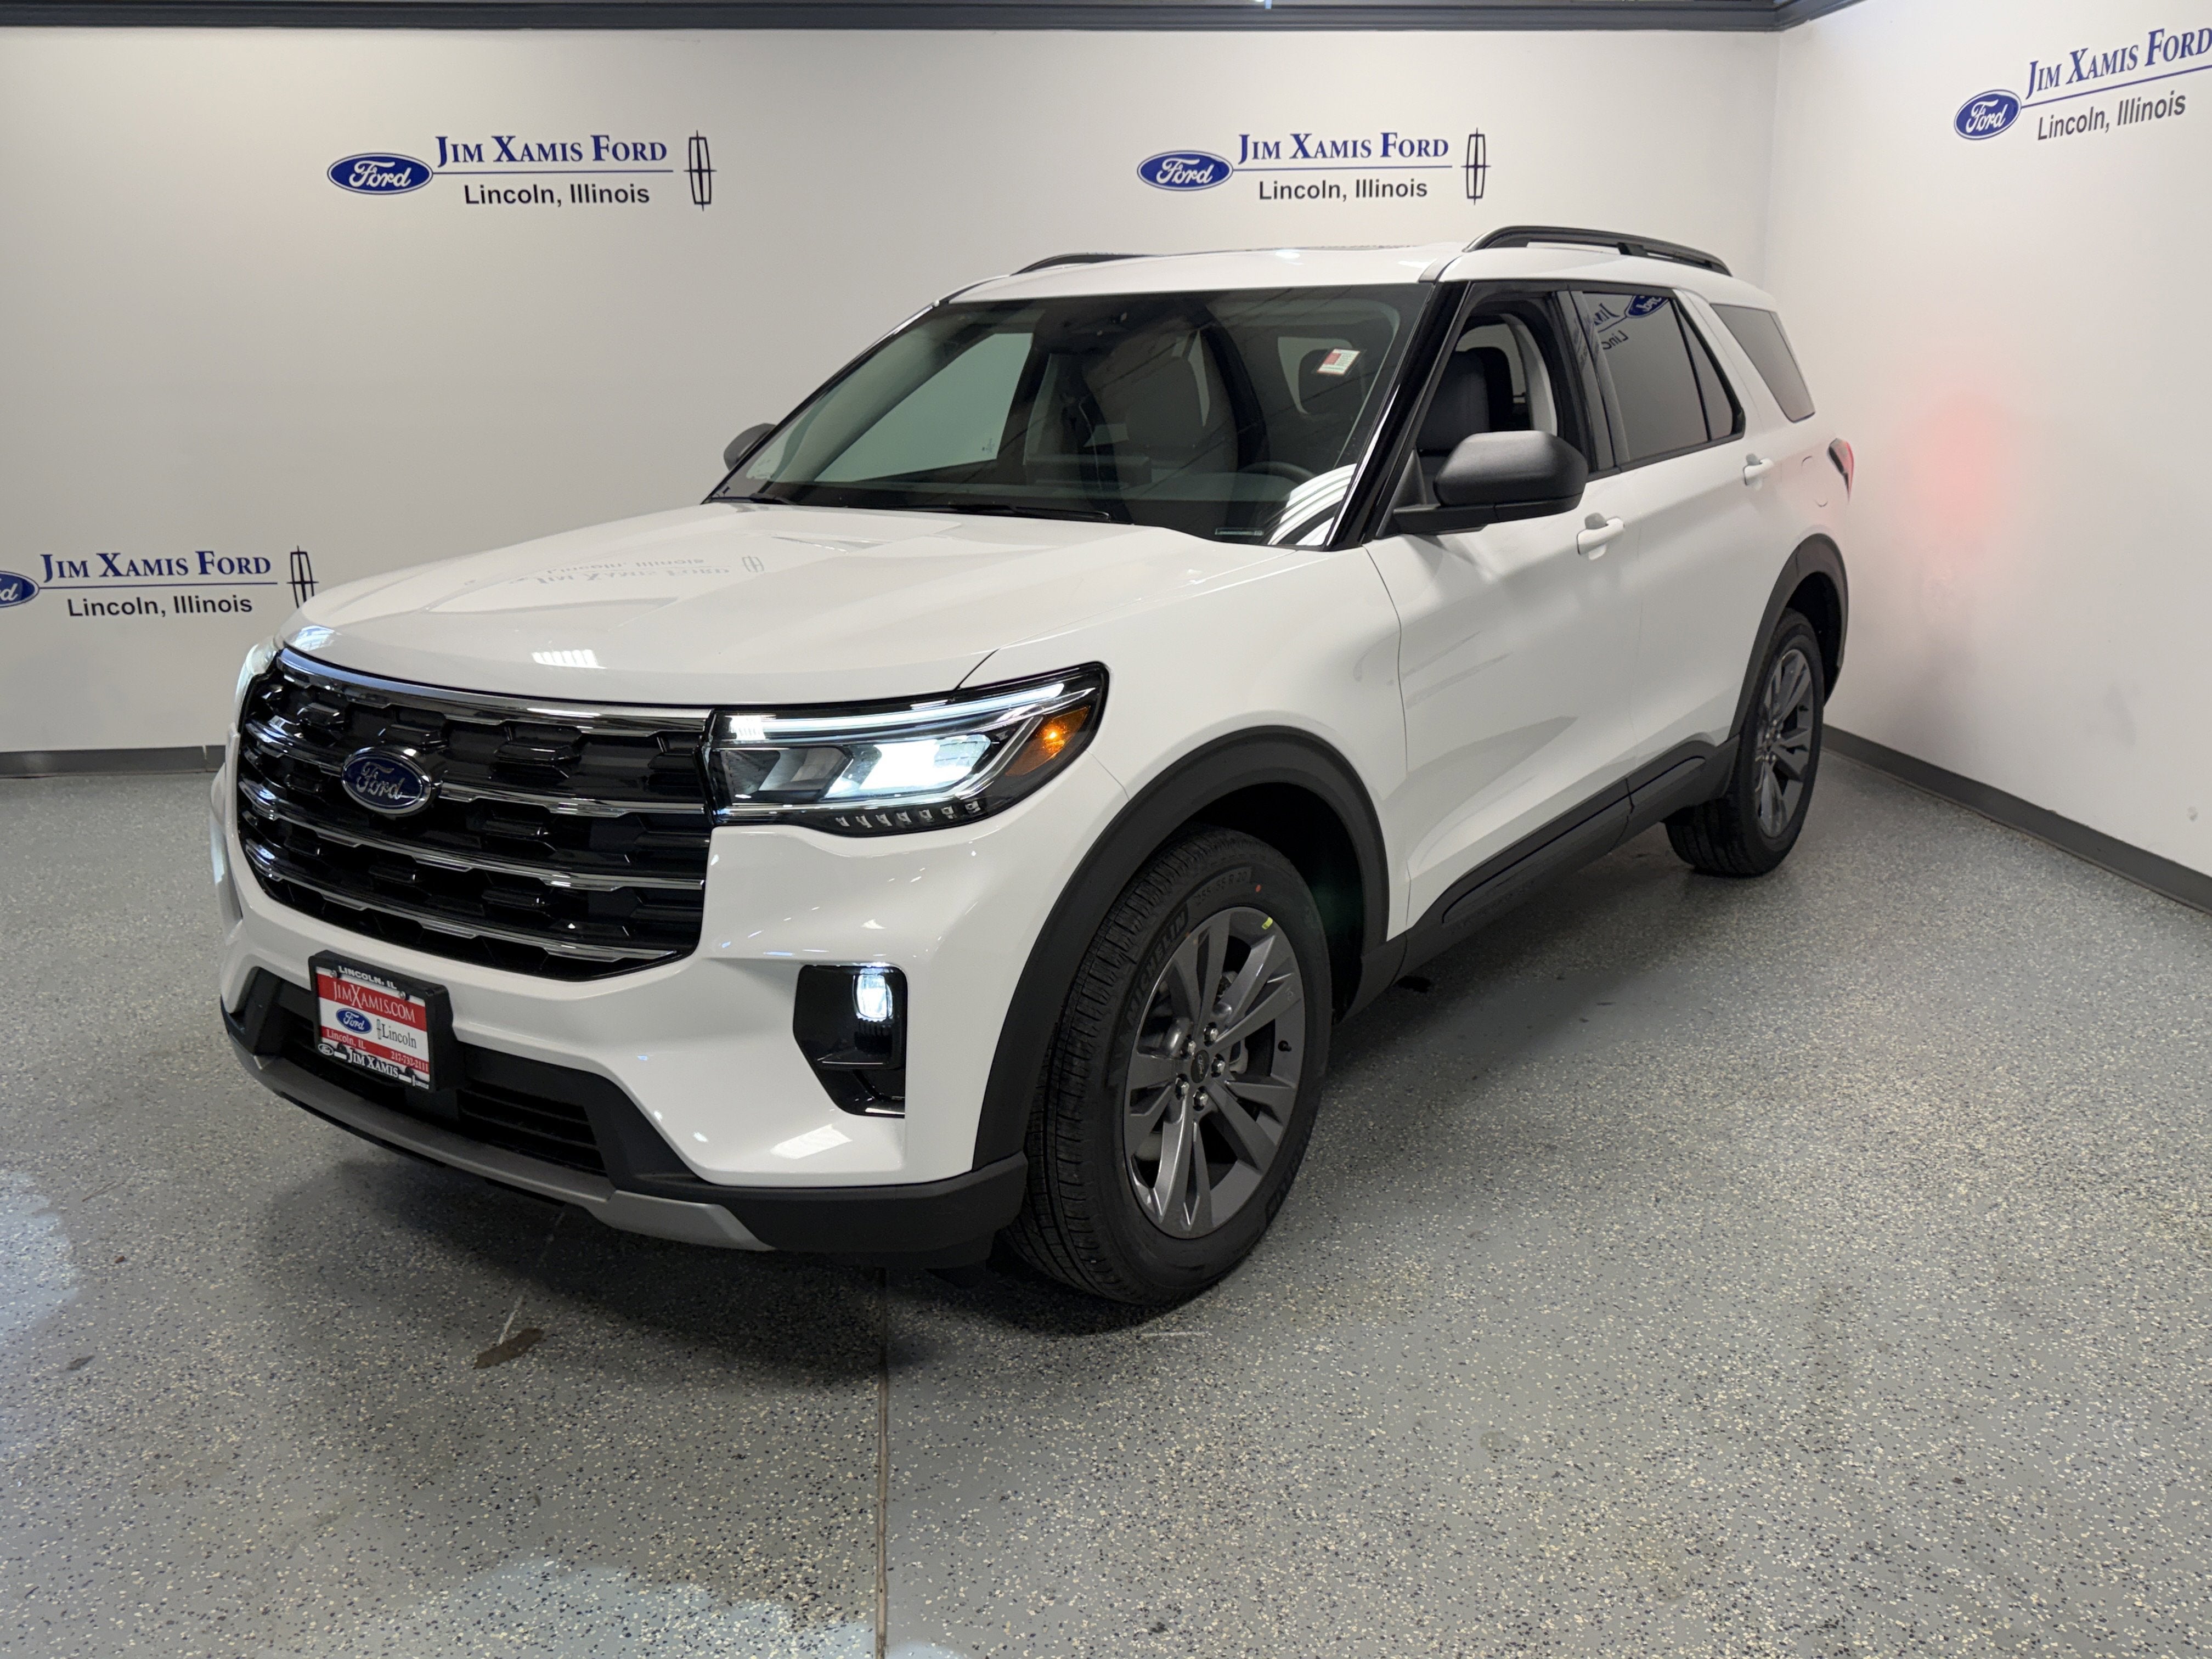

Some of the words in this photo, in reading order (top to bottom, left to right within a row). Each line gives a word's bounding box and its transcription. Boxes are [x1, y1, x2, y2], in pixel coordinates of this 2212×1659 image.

[2026, 60, 2061, 100] JIM
[2066, 44, 2139, 85] XAMIS
[2145, 27, 2212, 67] FORD
[1965, 99, 2008, 133] Ford
[2038, 106, 2110, 140] Lincoln,
[2116, 90, 2186, 126] Illinois
[436, 136, 484, 168] JIM
[492, 134, 583, 162] XAMIS
[590, 134, 668, 162] FORD
[1238, 134, 1282, 165] JIM
[1289, 133, 1372, 159] XAMIS
[1380, 132, 1449, 157] FORD
[348, 160, 411, 188] Ford
[1155, 157, 1214, 184] Ford
[464, 184, 562, 207] Lincoln,
[569, 183, 651, 205] Illinois
[1259, 180, 1347, 201] Lincoln,
[1355, 179, 1427, 198] Illinois
[40, 554, 89, 583] JIM
[97, 552, 189, 577] XAMIS
[195, 550, 272, 575] FORD
[67, 597, 166, 617] Lincoln,
[173, 595, 253, 613] Illinois
[357, 761, 405, 800] Ford
[1126, 910, 1187, 1024] MICHELIN
[386, 980, 397, 990] IL
[333, 981, 416, 1023] JIMXAMIS.COM
[342, 1011, 365, 1031] Ford
[381, 1023, 417, 1048] Lincoln
[358, 1041, 366, 1049] IL
[348, 1047, 365, 1066] JIM
[367, 1054, 399, 1077] XAMIS
